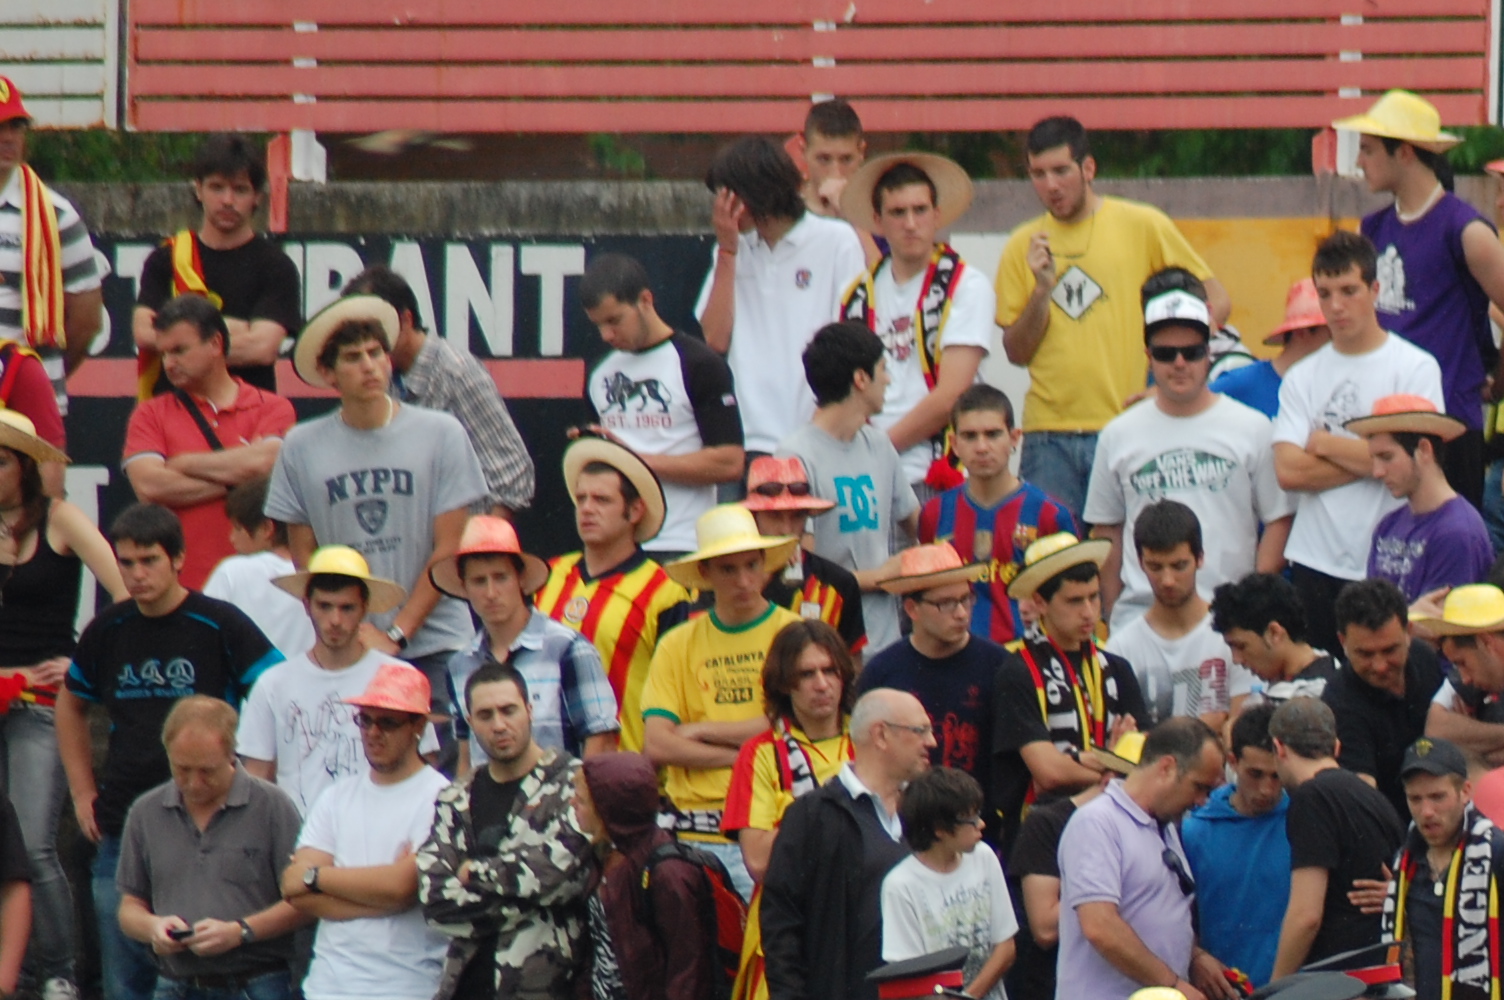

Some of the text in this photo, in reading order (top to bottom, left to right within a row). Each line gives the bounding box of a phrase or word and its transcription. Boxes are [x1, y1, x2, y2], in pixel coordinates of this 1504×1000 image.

[325, 468, 414, 506] NYPD
[833, 473, 879, 533] DC
[705, 650, 766, 669] CATALUNYA
